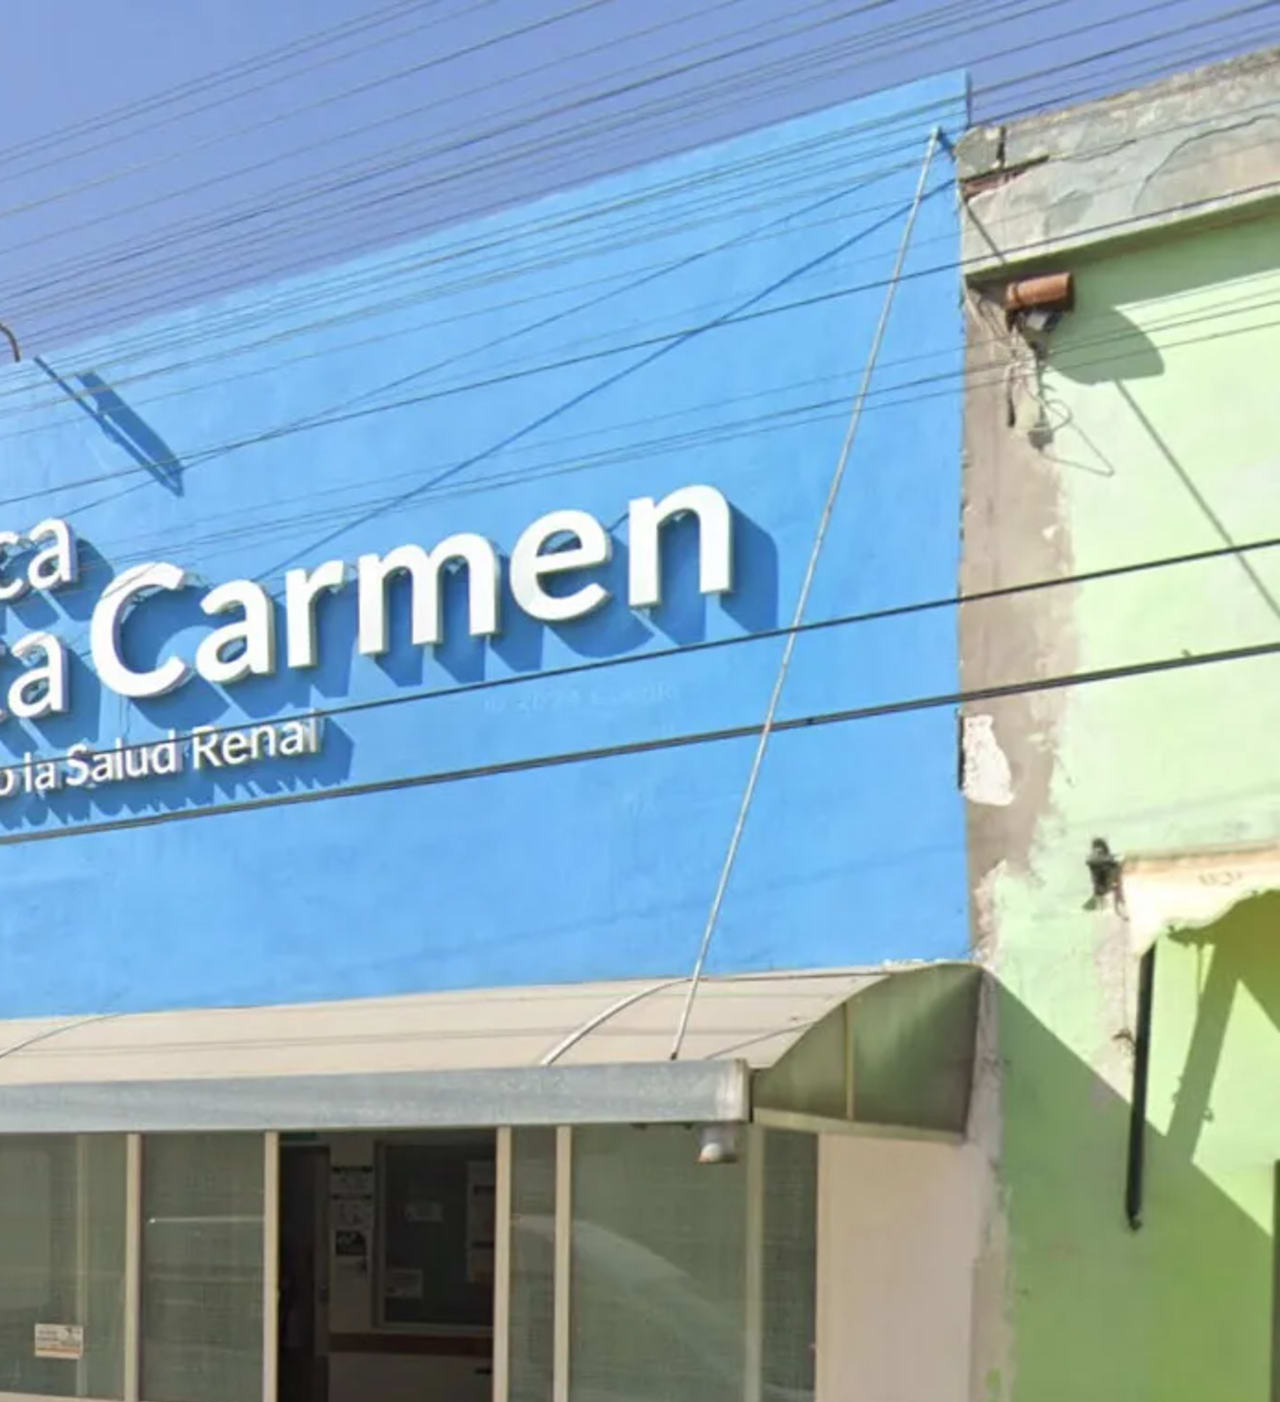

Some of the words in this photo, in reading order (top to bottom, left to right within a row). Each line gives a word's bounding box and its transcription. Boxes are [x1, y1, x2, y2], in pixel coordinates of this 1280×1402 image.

[89, 484, 732, 700] Carmen
[23, 752, 56, 793] la
[66, 731, 177, 787] Salud
[191, 709, 320, 771] Renal
